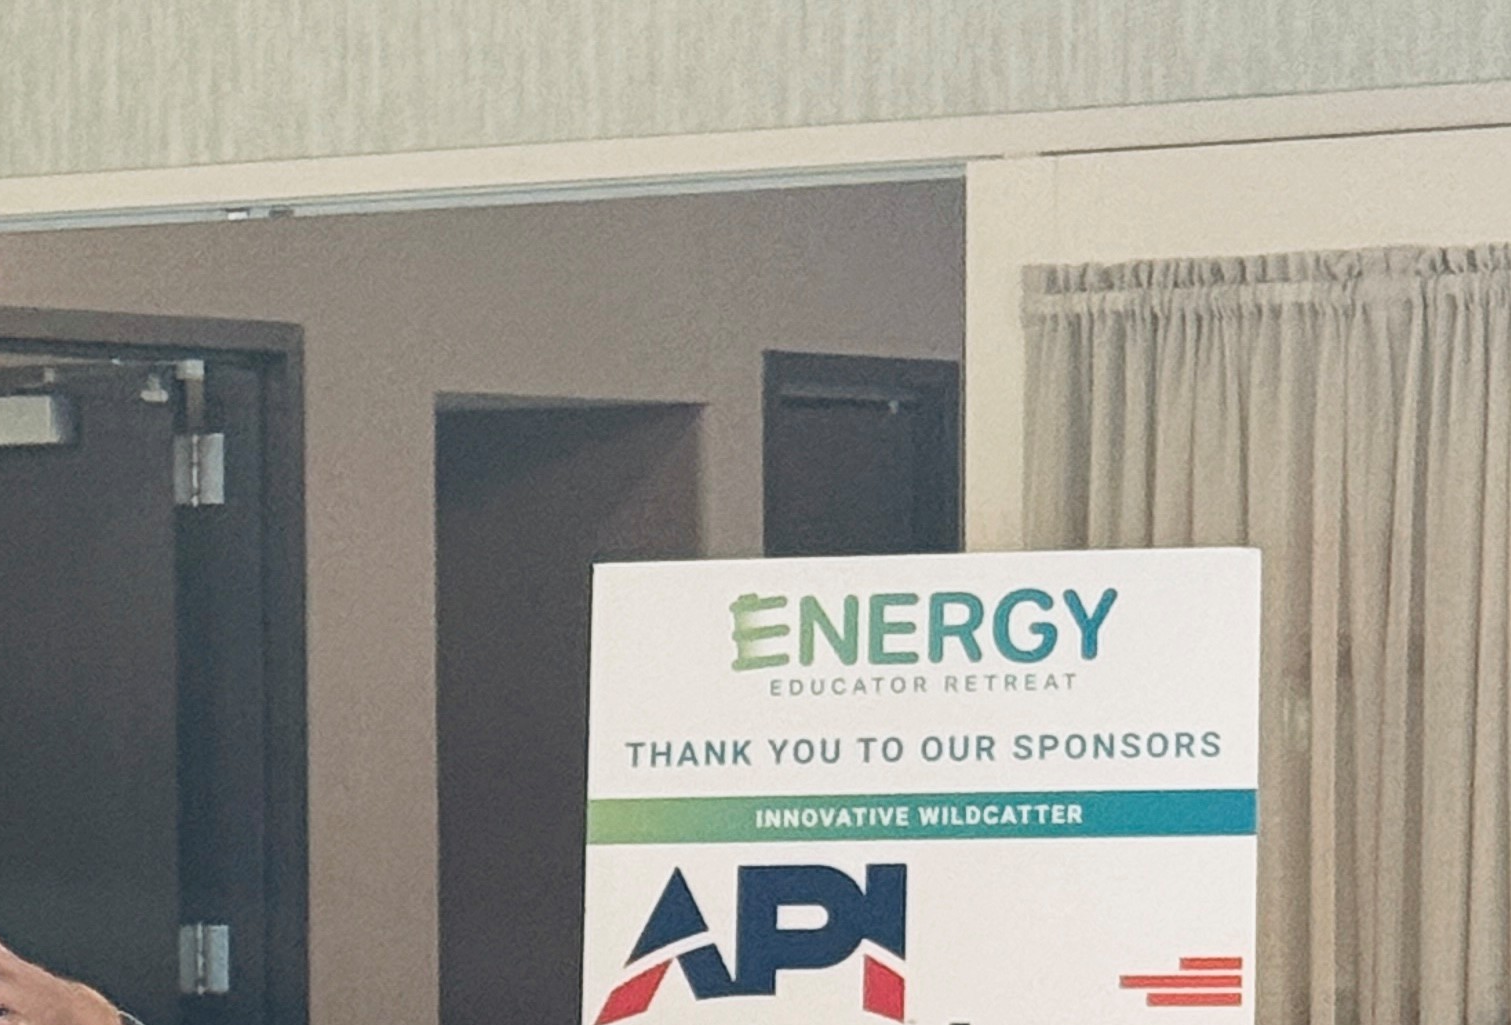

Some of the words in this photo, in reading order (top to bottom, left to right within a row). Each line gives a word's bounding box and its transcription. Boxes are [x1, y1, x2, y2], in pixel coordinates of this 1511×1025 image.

[730, 588, 1118, 670] ENERGY
[770, 676, 926, 696] EDUCATOR
[945, 673, 1076, 692] RETREAT
[626, 740, 751, 767] THANK
[768, 738, 840, 764] YOU
[857, 737, 903, 763] TO
[921, 735, 995, 761] OUR
[1013, 732, 1220, 760] SPONSORS
[757, 806, 909, 827] INNOVATIVE
[919, 804, 1082, 825] WILDCATTER
